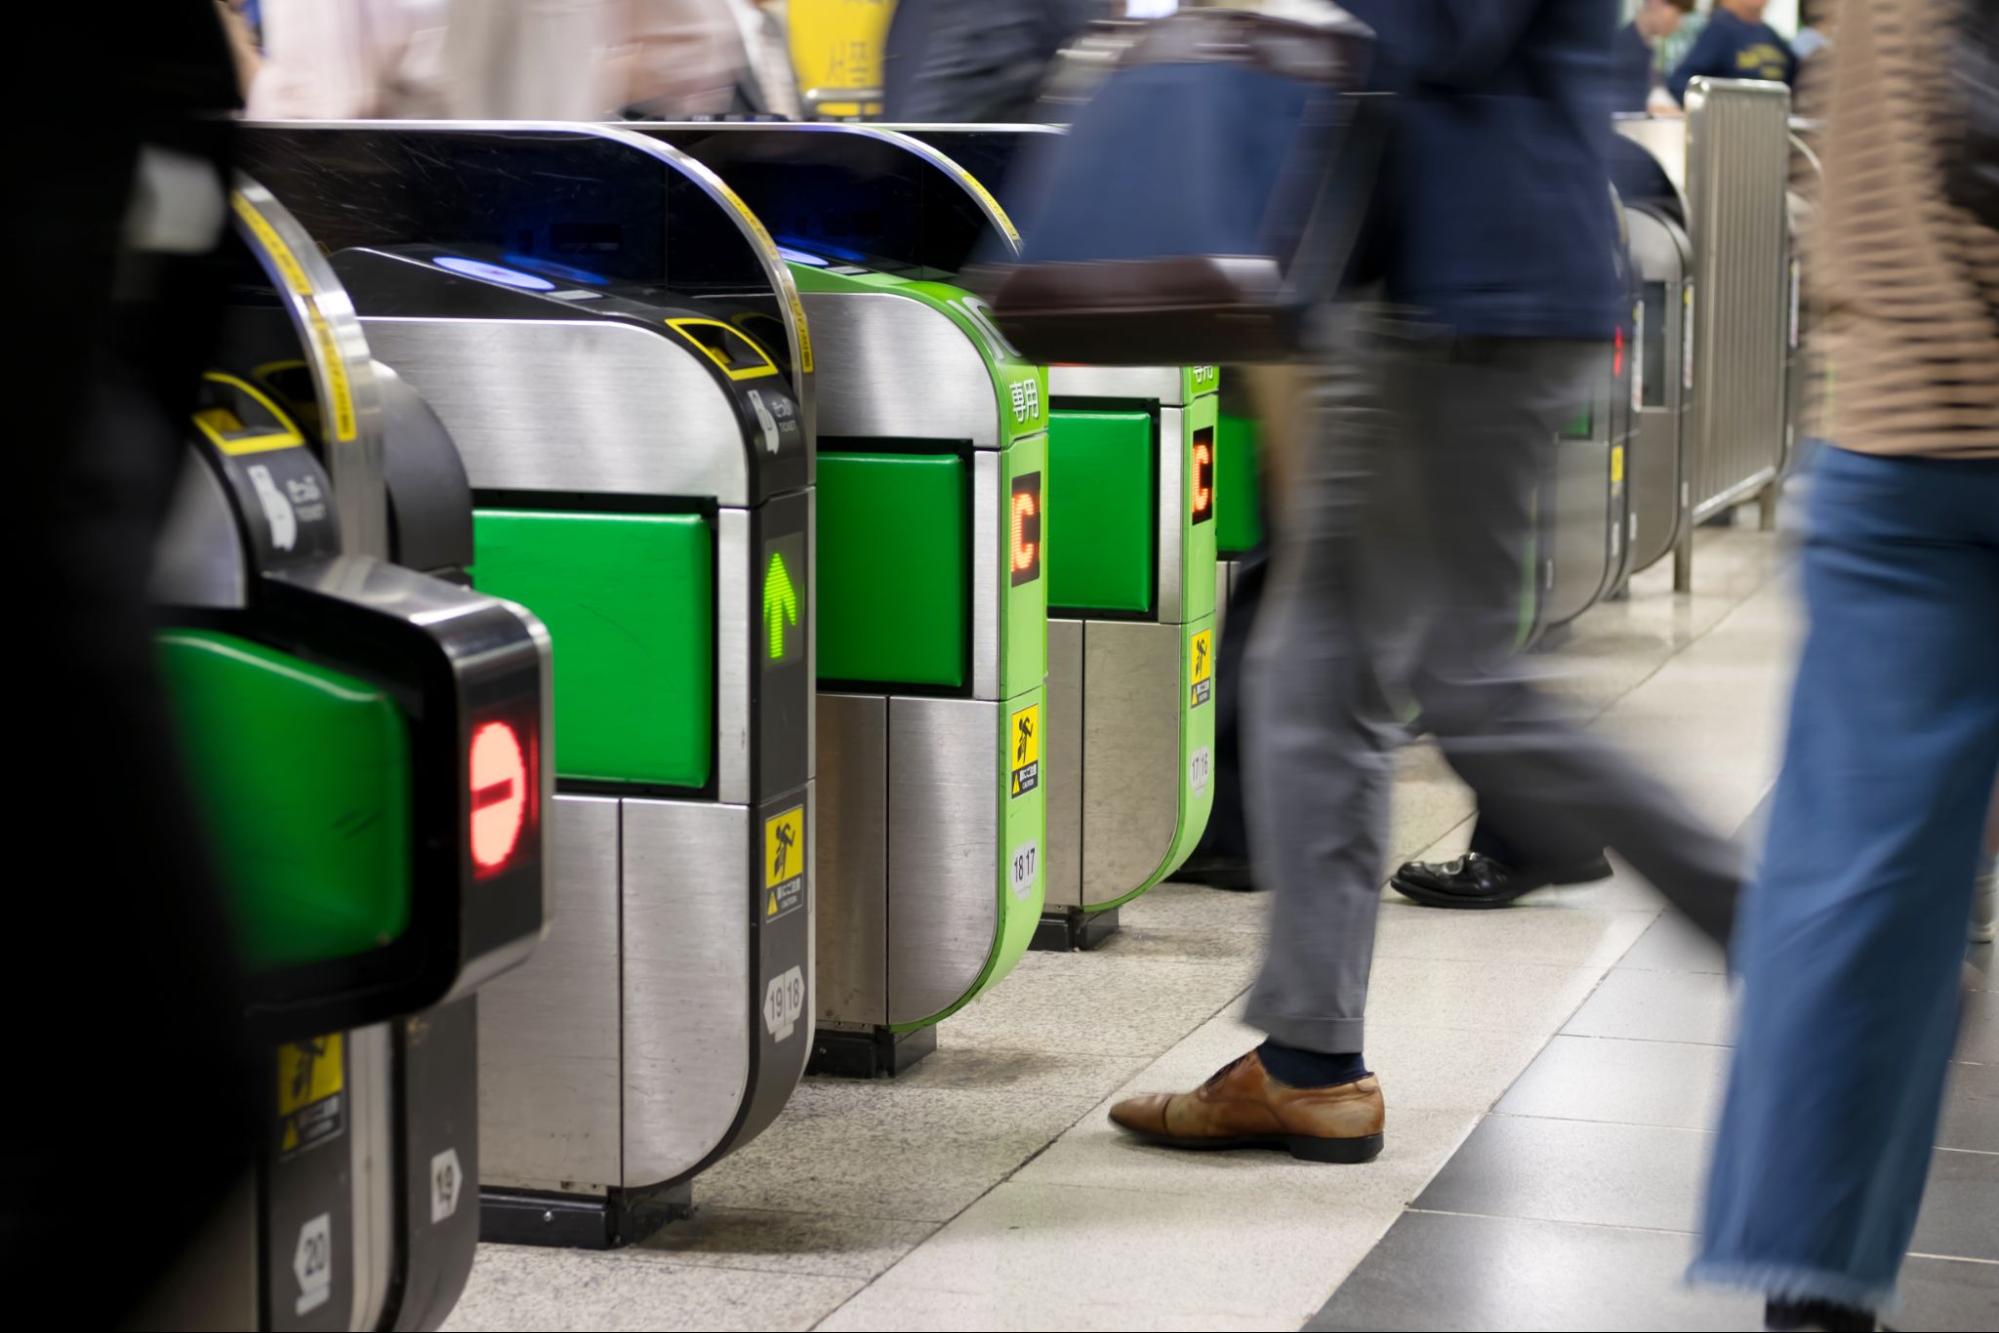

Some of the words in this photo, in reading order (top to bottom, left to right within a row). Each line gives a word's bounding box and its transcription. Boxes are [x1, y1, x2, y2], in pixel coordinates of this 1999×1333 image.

[1010, 379, 1040, 422] 専用
[1014, 855, 1023, 882] 18
[1025, 848, 1035, 875] 17
[770, 986, 783, 1020] 19
